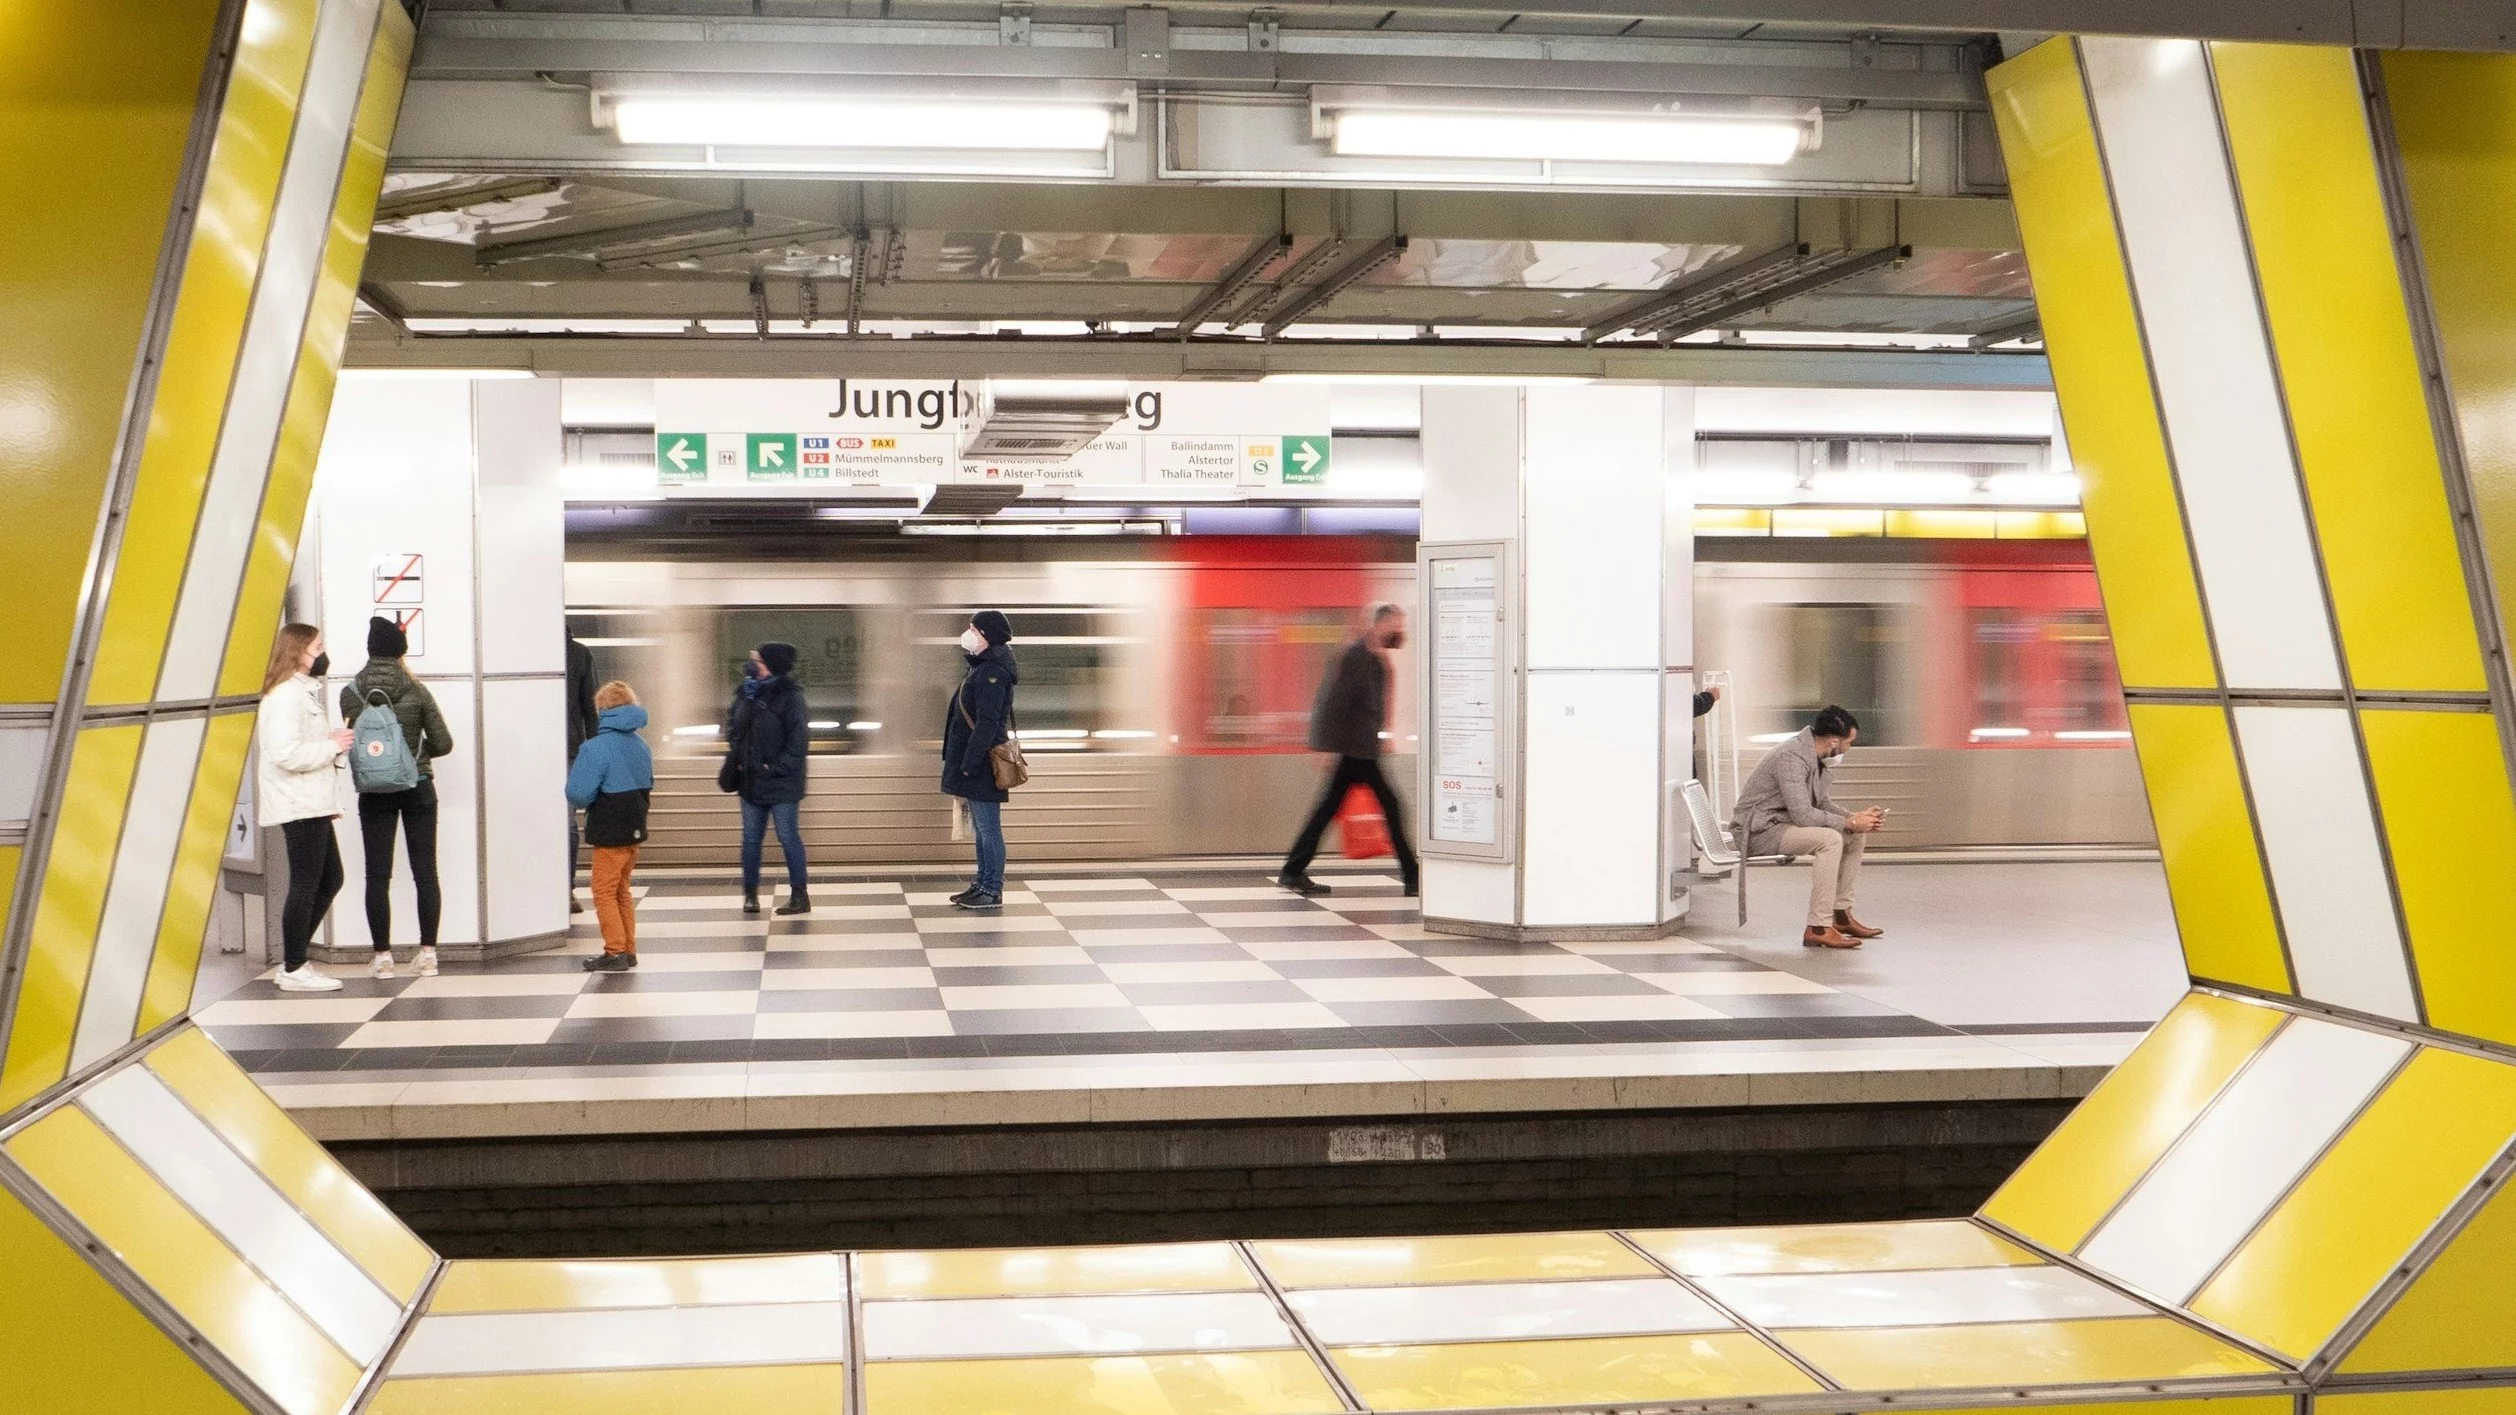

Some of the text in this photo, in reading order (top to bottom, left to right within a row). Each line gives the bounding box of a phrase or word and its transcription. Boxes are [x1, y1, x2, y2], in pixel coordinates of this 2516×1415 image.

[808, 438, 824, 448] U1
[839, 438, 895, 449] BUS TAXI
[1085, 441, 1128, 451] uer Wall
[1170, 441, 1234, 451] Ballindamm
[808, 453, 825, 463] U2
[835, 453, 944, 466] Mümmelmannsberg
[1188, 455, 1234, 465] Alstertor
[808, 468, 825, 478] U4
[835, 468, 880, 478] Billstedt
[963, 465, 979, 474] WC
[1003, 469, 1084, 479] Alster-Touristik
[1161, 469, 1234, 479] Thalia Theater
[1442, 780, 1462, 790] SOS
